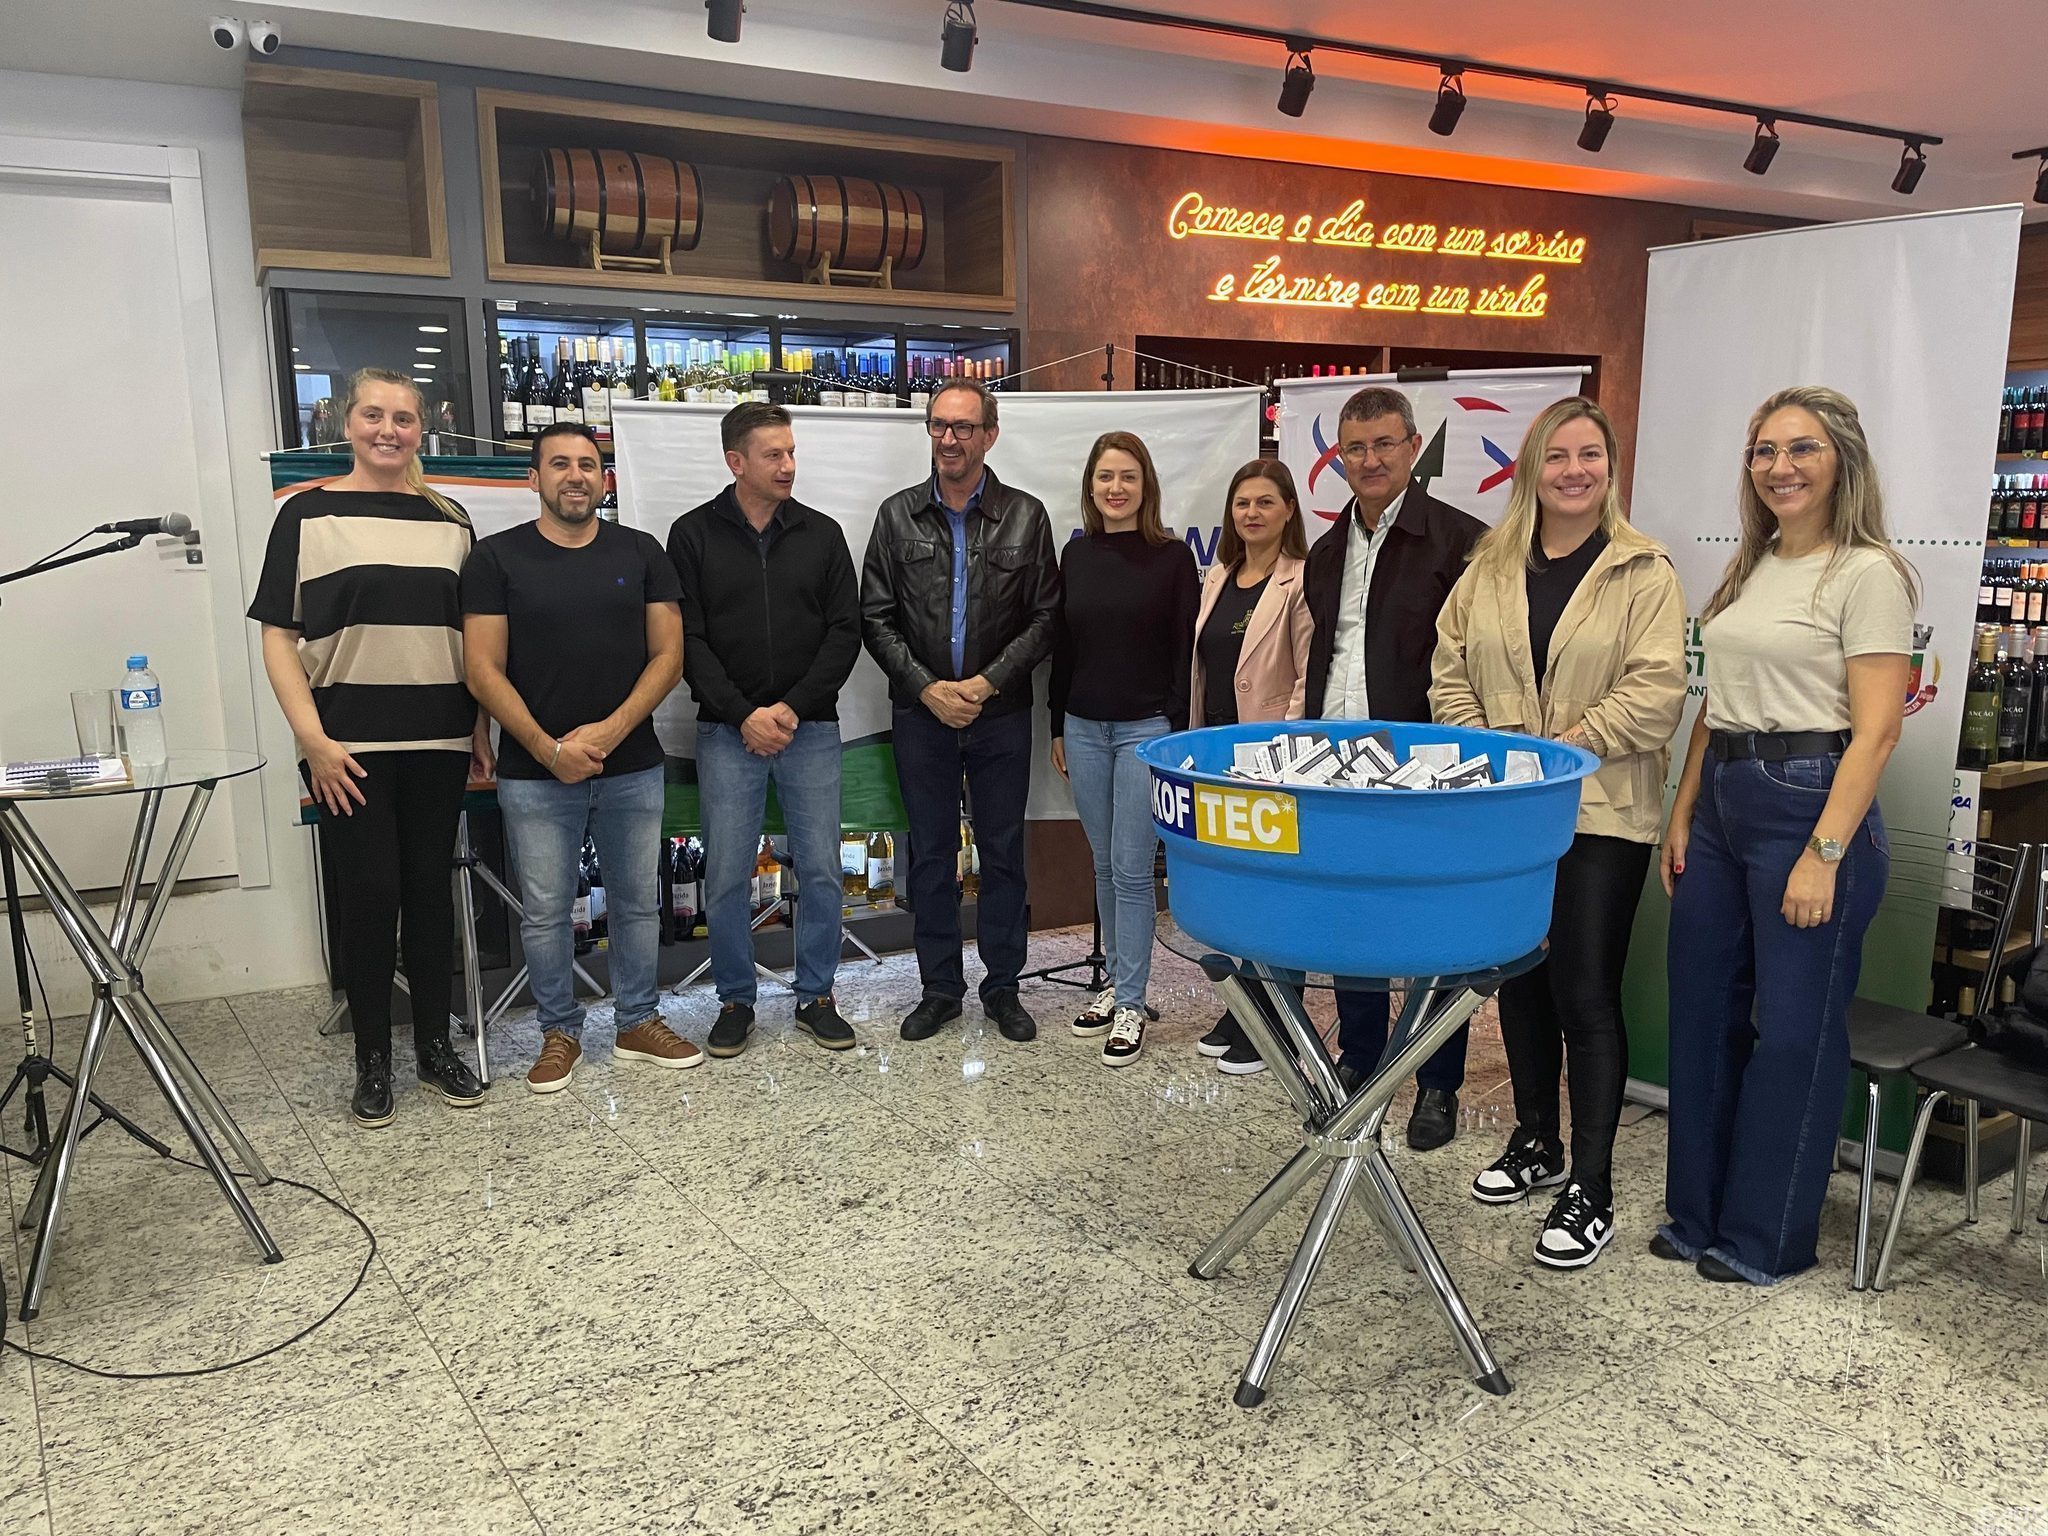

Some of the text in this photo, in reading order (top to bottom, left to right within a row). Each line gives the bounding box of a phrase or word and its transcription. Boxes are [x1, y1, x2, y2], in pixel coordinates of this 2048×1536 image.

[1169, 191, 1588, 261] Comece o dia com um sorriso
[1214, 254, 1549, 315] e termine com um vinho
